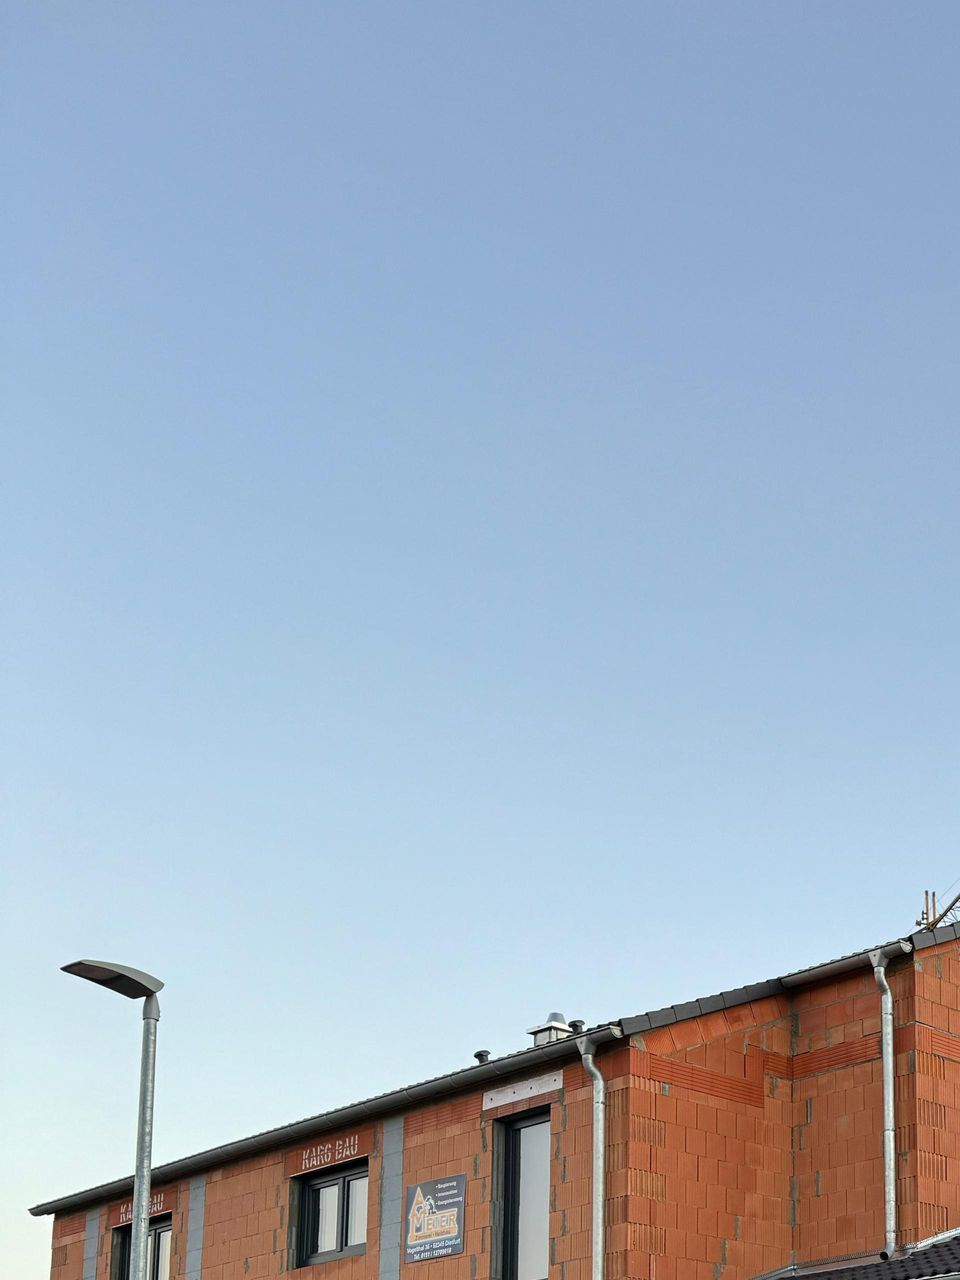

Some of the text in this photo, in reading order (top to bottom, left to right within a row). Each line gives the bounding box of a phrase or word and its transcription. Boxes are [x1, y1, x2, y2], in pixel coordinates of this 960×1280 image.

[302, 1134, 359, 1170] KARG BAU
[411, 1212, 457, 1234] MEIER
